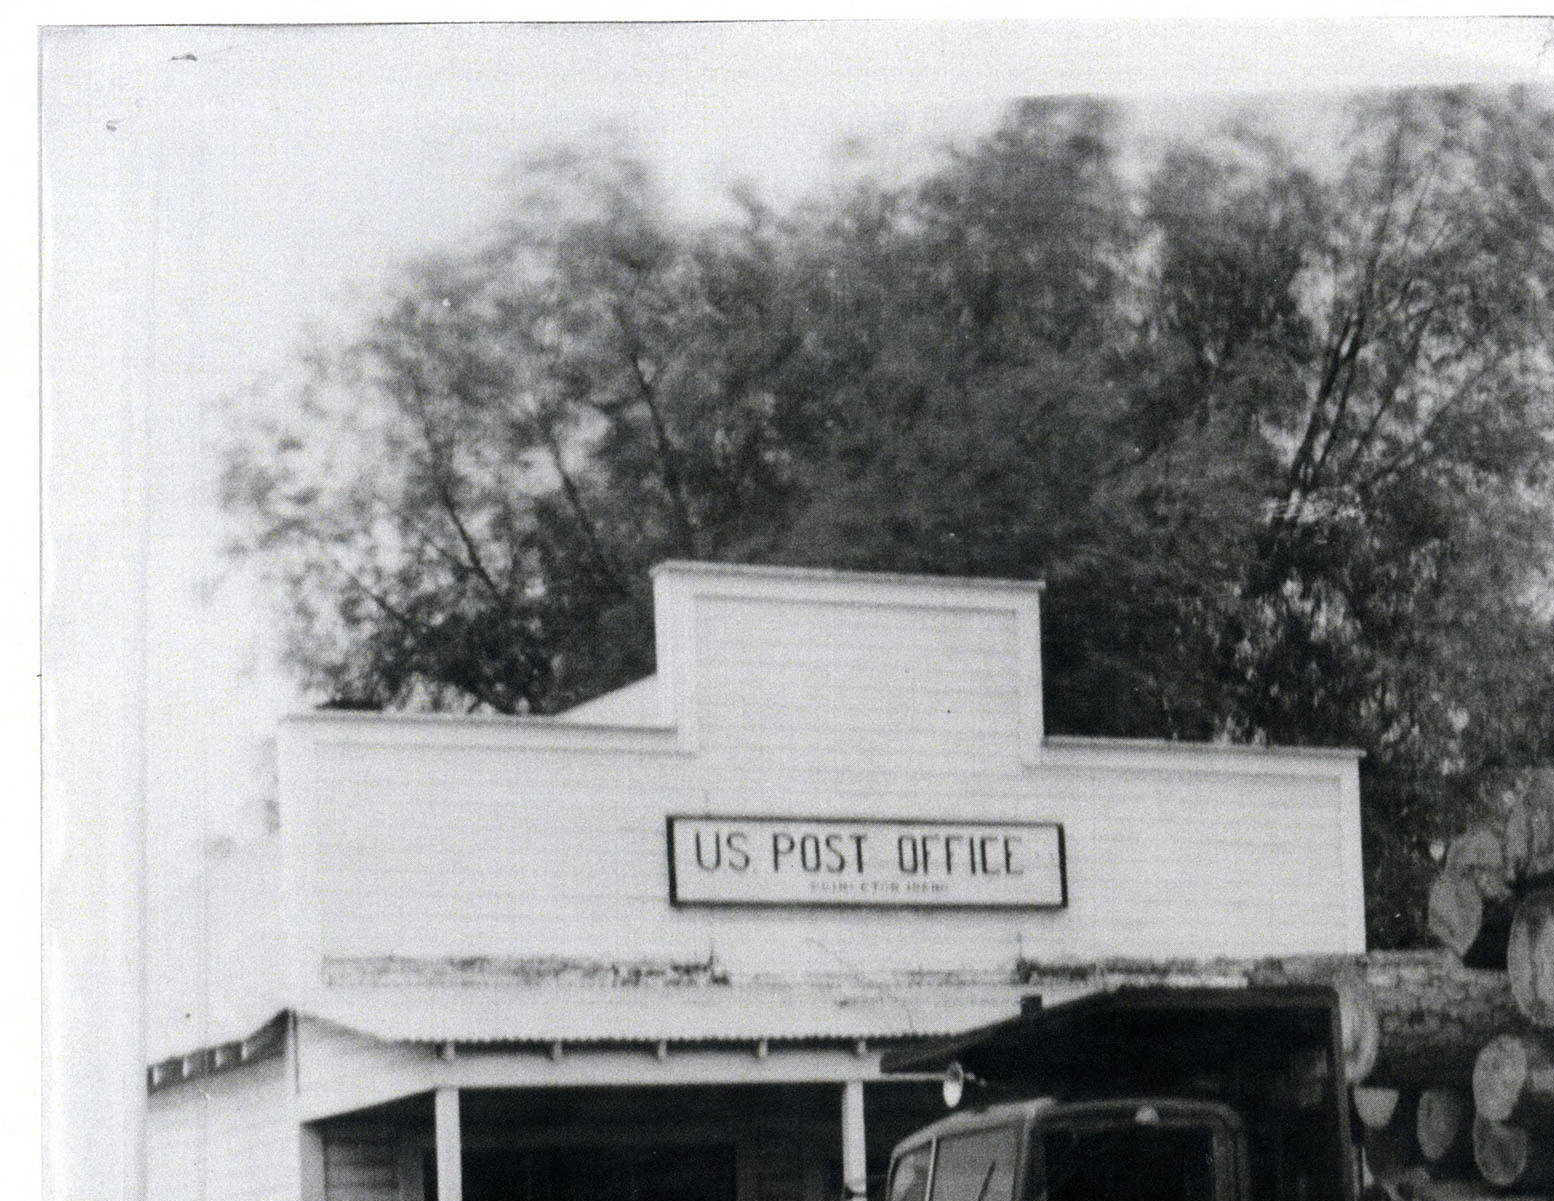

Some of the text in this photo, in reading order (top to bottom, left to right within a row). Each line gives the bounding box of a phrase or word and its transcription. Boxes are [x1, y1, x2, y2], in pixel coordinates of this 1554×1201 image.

[695, 831, 1025, 877] US POST OFFICE
